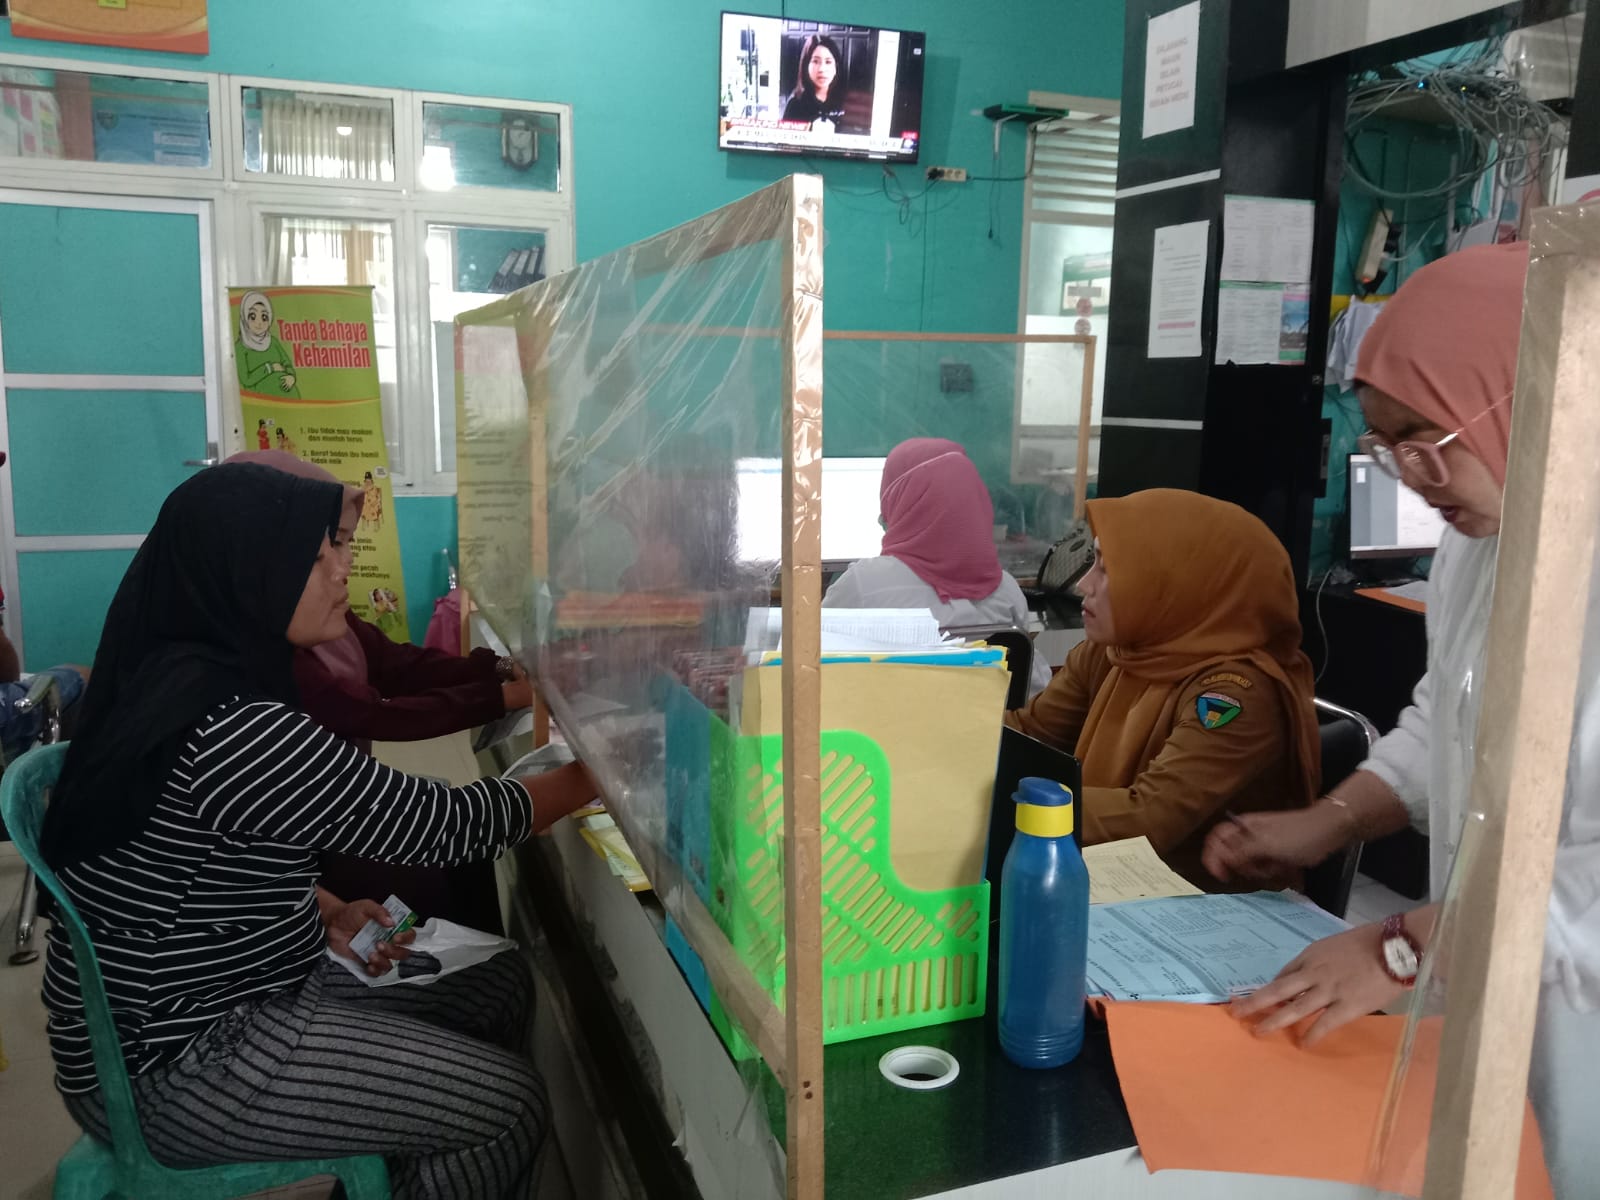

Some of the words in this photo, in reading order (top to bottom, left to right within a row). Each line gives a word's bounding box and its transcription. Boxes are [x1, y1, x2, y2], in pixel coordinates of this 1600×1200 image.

[277, 320, 316, 341] Tanda
[318, 320, 368, 342] Bahaya
[293, 343, 371, 368] Kehamilan
